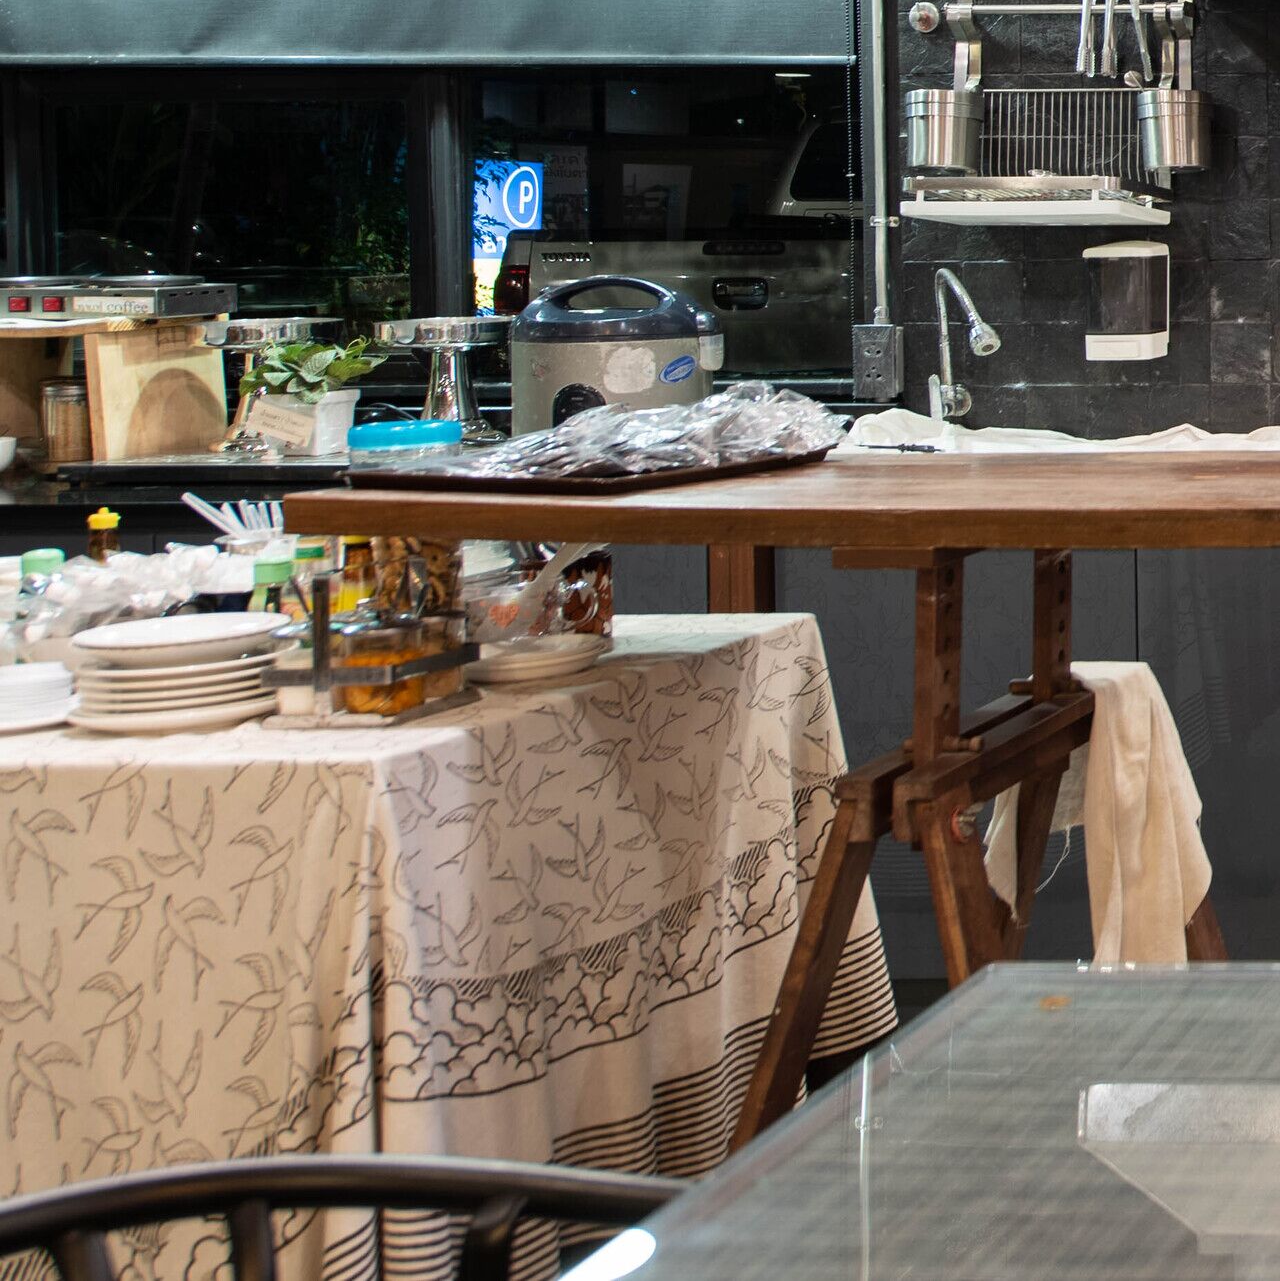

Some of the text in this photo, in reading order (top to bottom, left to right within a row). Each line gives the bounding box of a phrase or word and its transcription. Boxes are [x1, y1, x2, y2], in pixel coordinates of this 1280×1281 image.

[518, 181, 534, 214] P
[542, 252, 592, 262] TOYOTA
[107, 300, 148, 313] coffee
